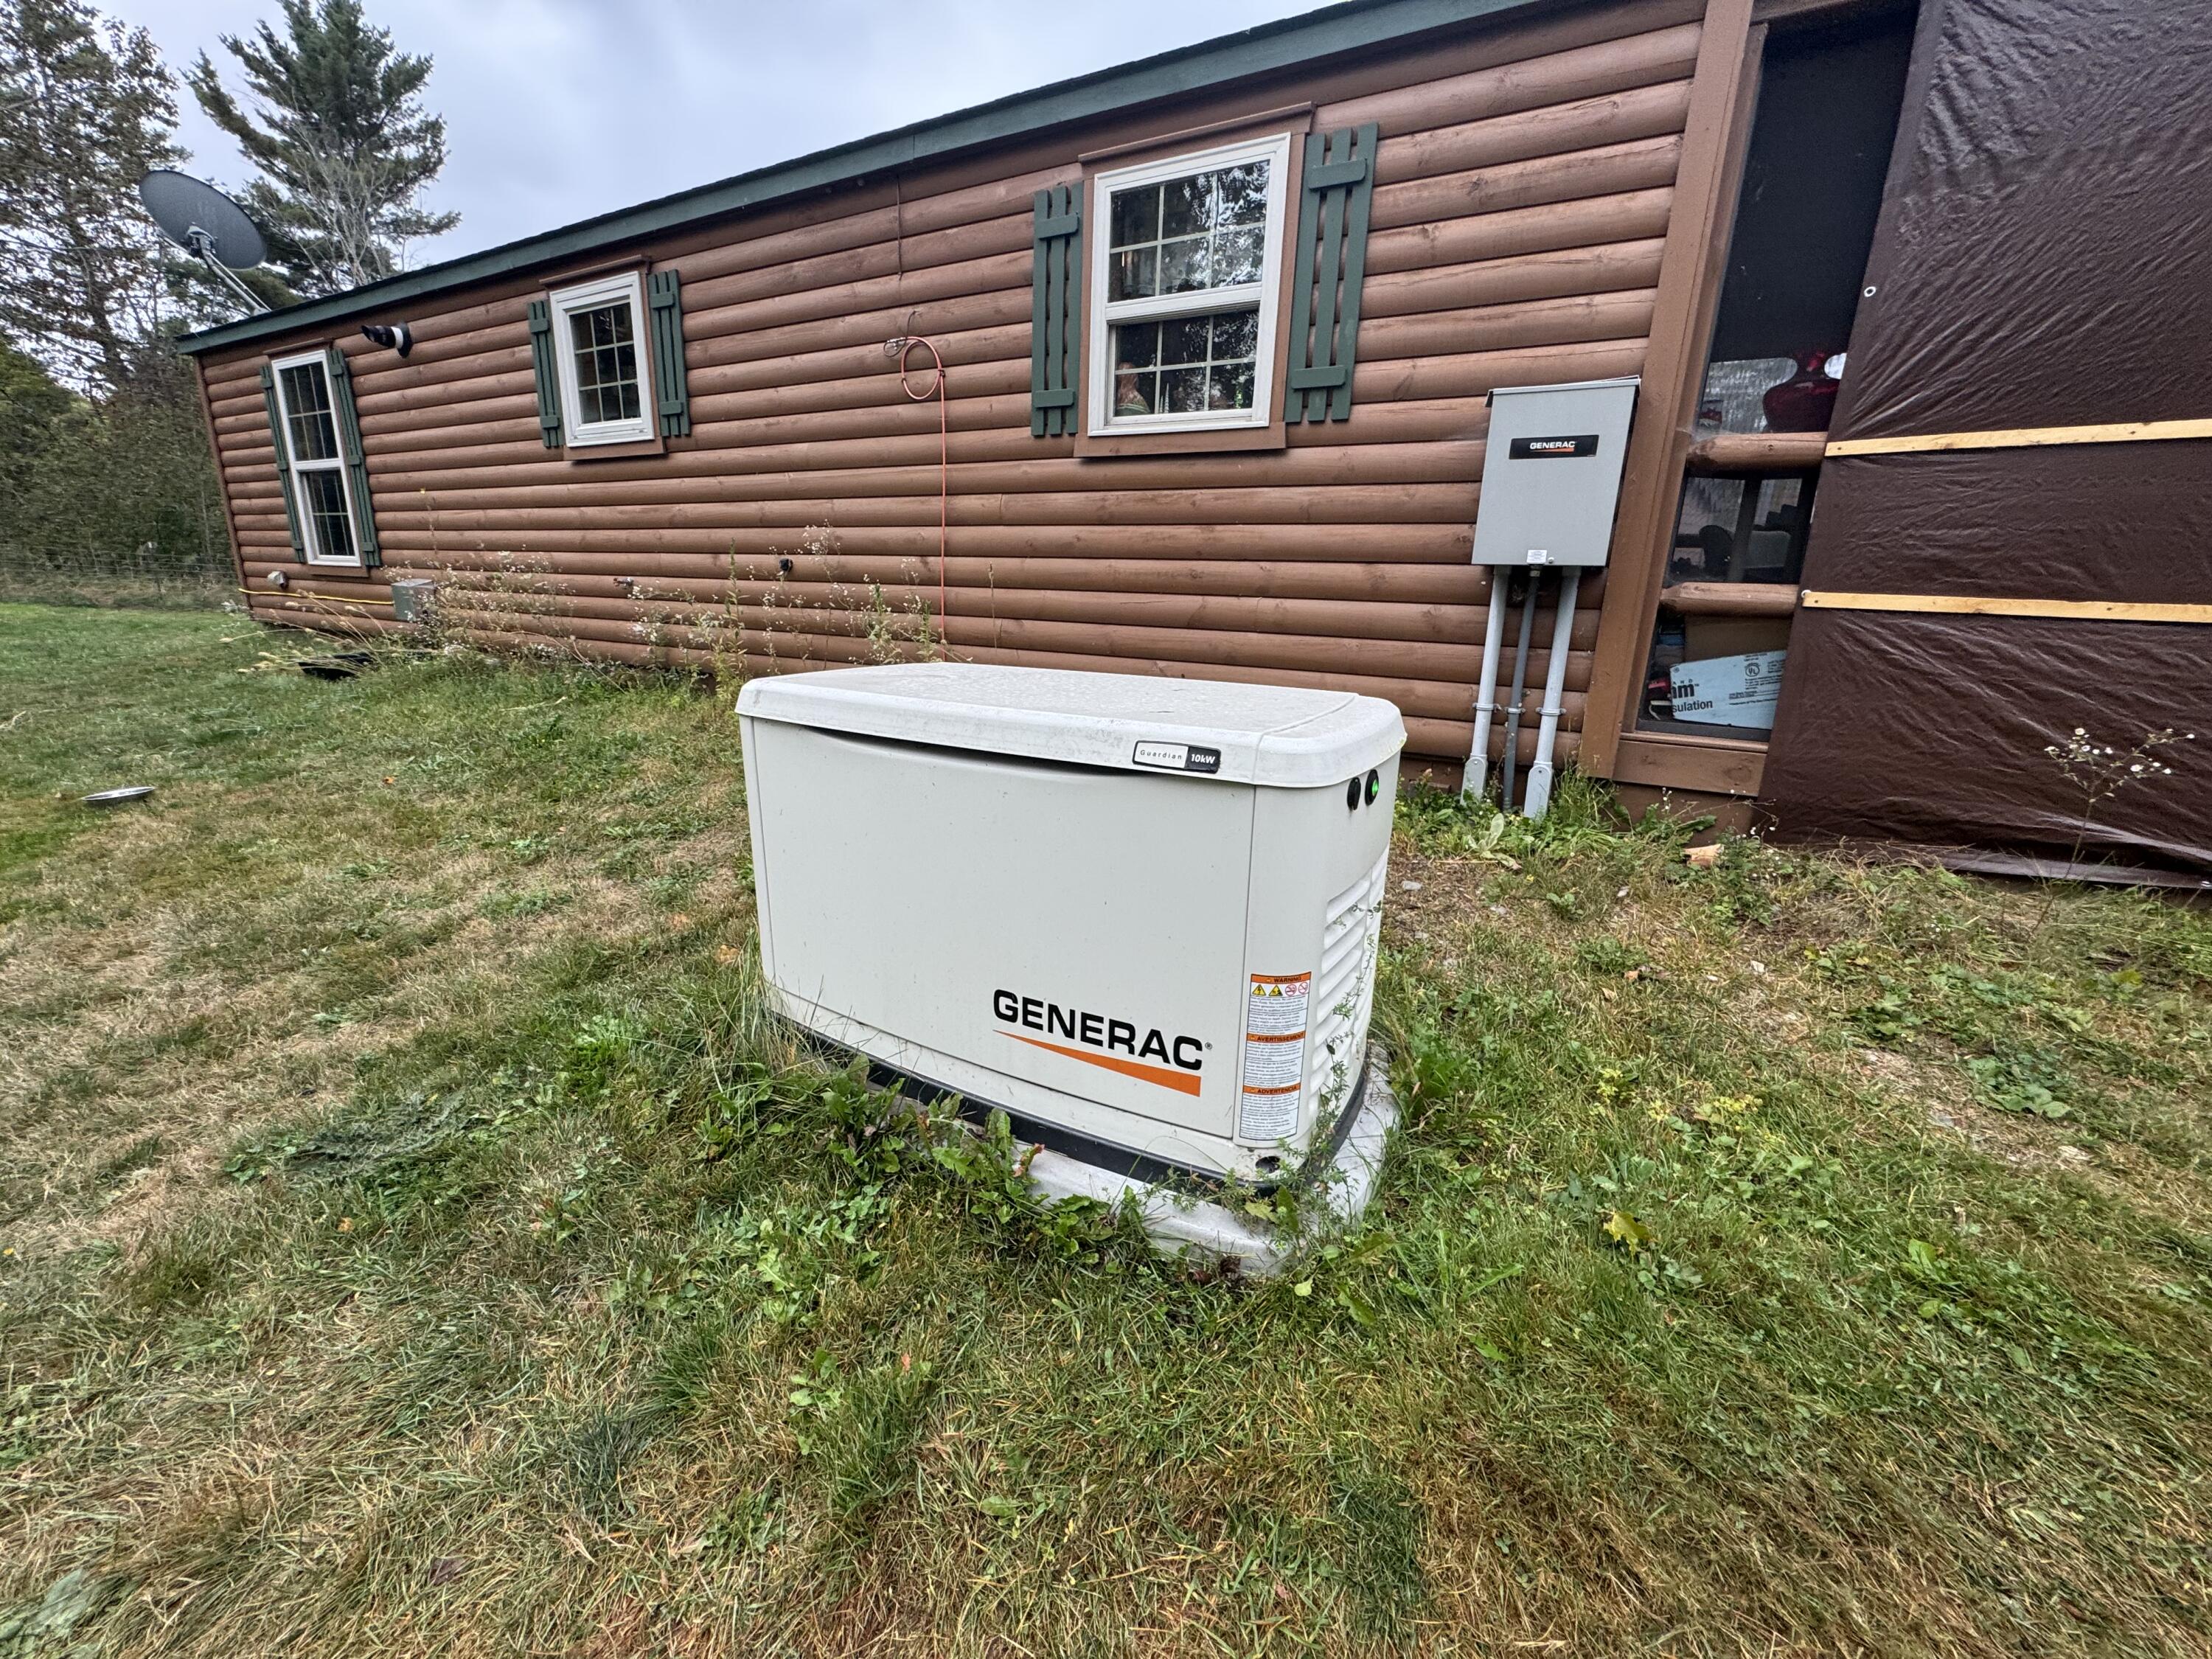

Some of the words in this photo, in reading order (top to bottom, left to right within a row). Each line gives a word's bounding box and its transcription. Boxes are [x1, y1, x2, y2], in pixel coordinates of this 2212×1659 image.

[1530, 441, 1576, 450] GENERAC
[1672, 700, 1714, 713] sulation
[1140, 749, 1182, 760] Guardian
[1191, 754, 1216, 765] 10kW
[1257, 1032, 1304, 1042] AVERTISSEMENT
[1257, 1085, 1297, 1094] ADVERTENCIA
